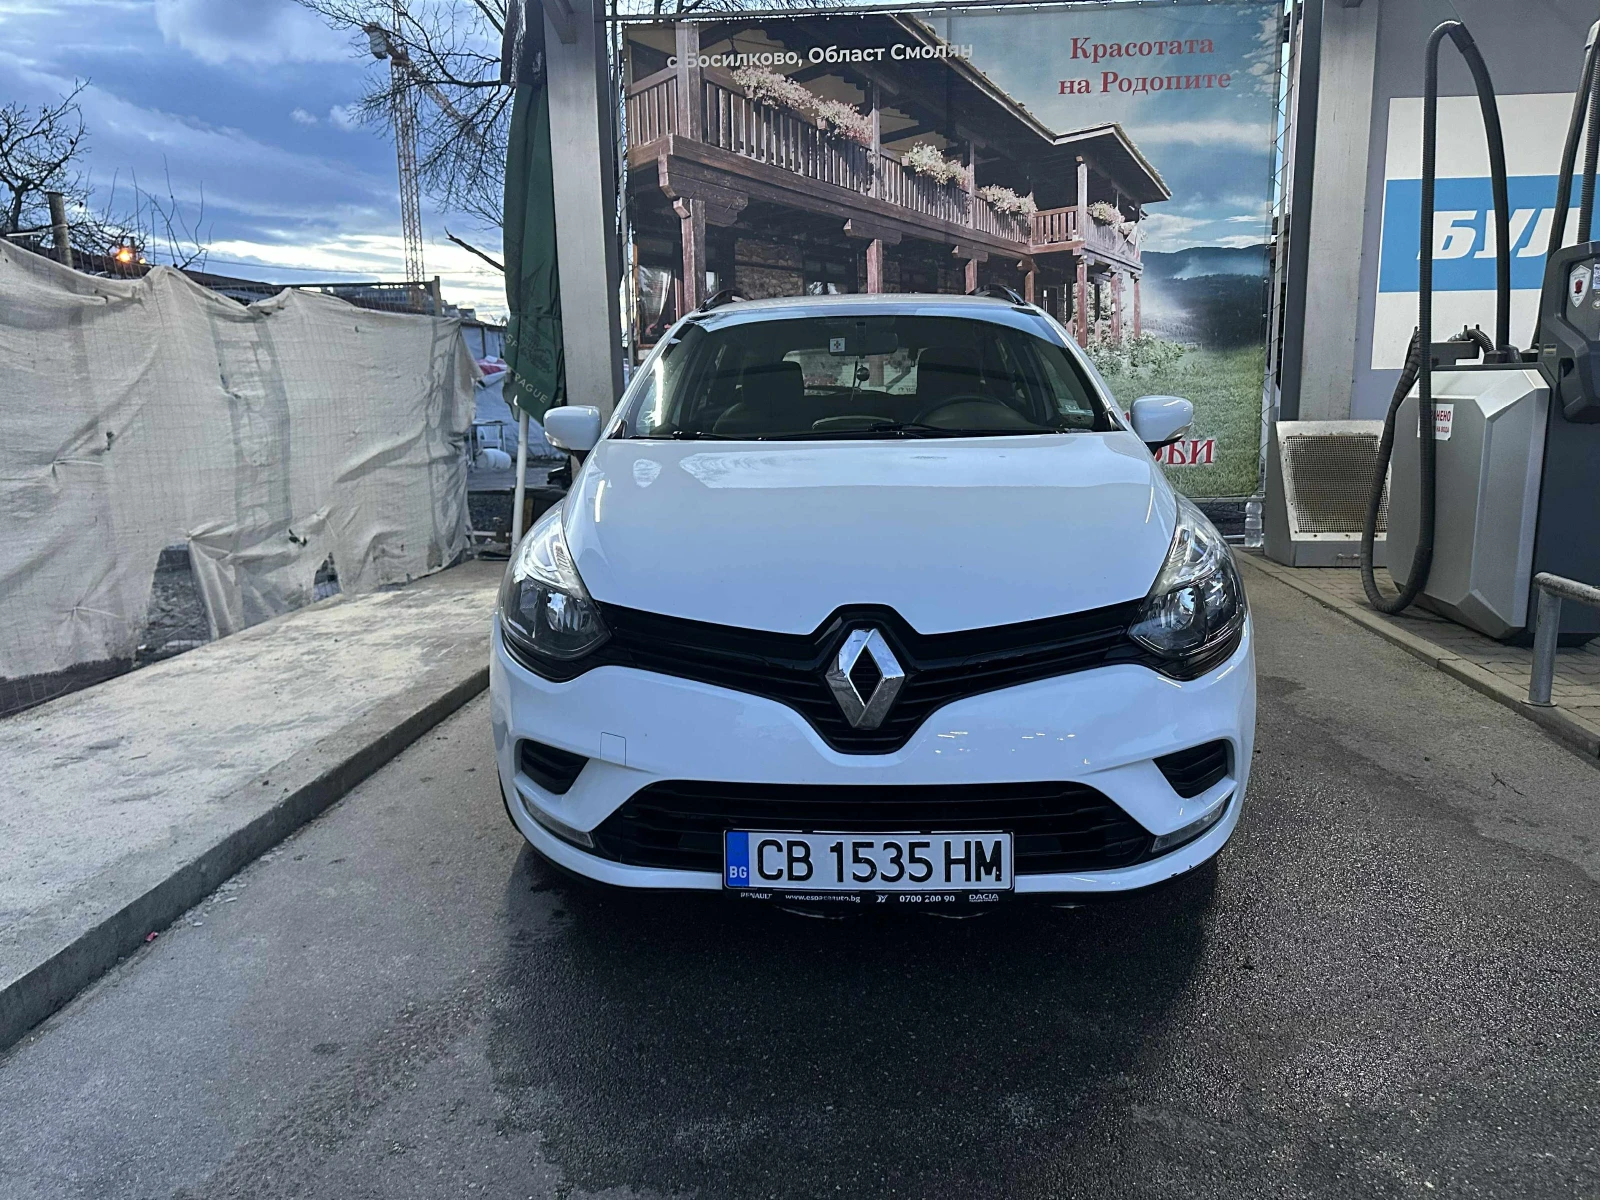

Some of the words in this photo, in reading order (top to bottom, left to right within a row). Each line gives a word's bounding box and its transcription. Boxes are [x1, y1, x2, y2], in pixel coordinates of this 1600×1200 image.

[686, 50, 802, 69] Босилково,
[808, 45, 886, 64] Област
[890, 43, 974, 60] Смолян
[1069, 36, 1215, 64] Красотата
[1058, 79, 1092, 95] на
[1100, 71, 1232, 96] Родопите
[729, 865, 748, 879] BG
[829, 841, 934, 883] 1535
[899, 894, 922, 903] 0700
[943, 894, 956, 903] 90
